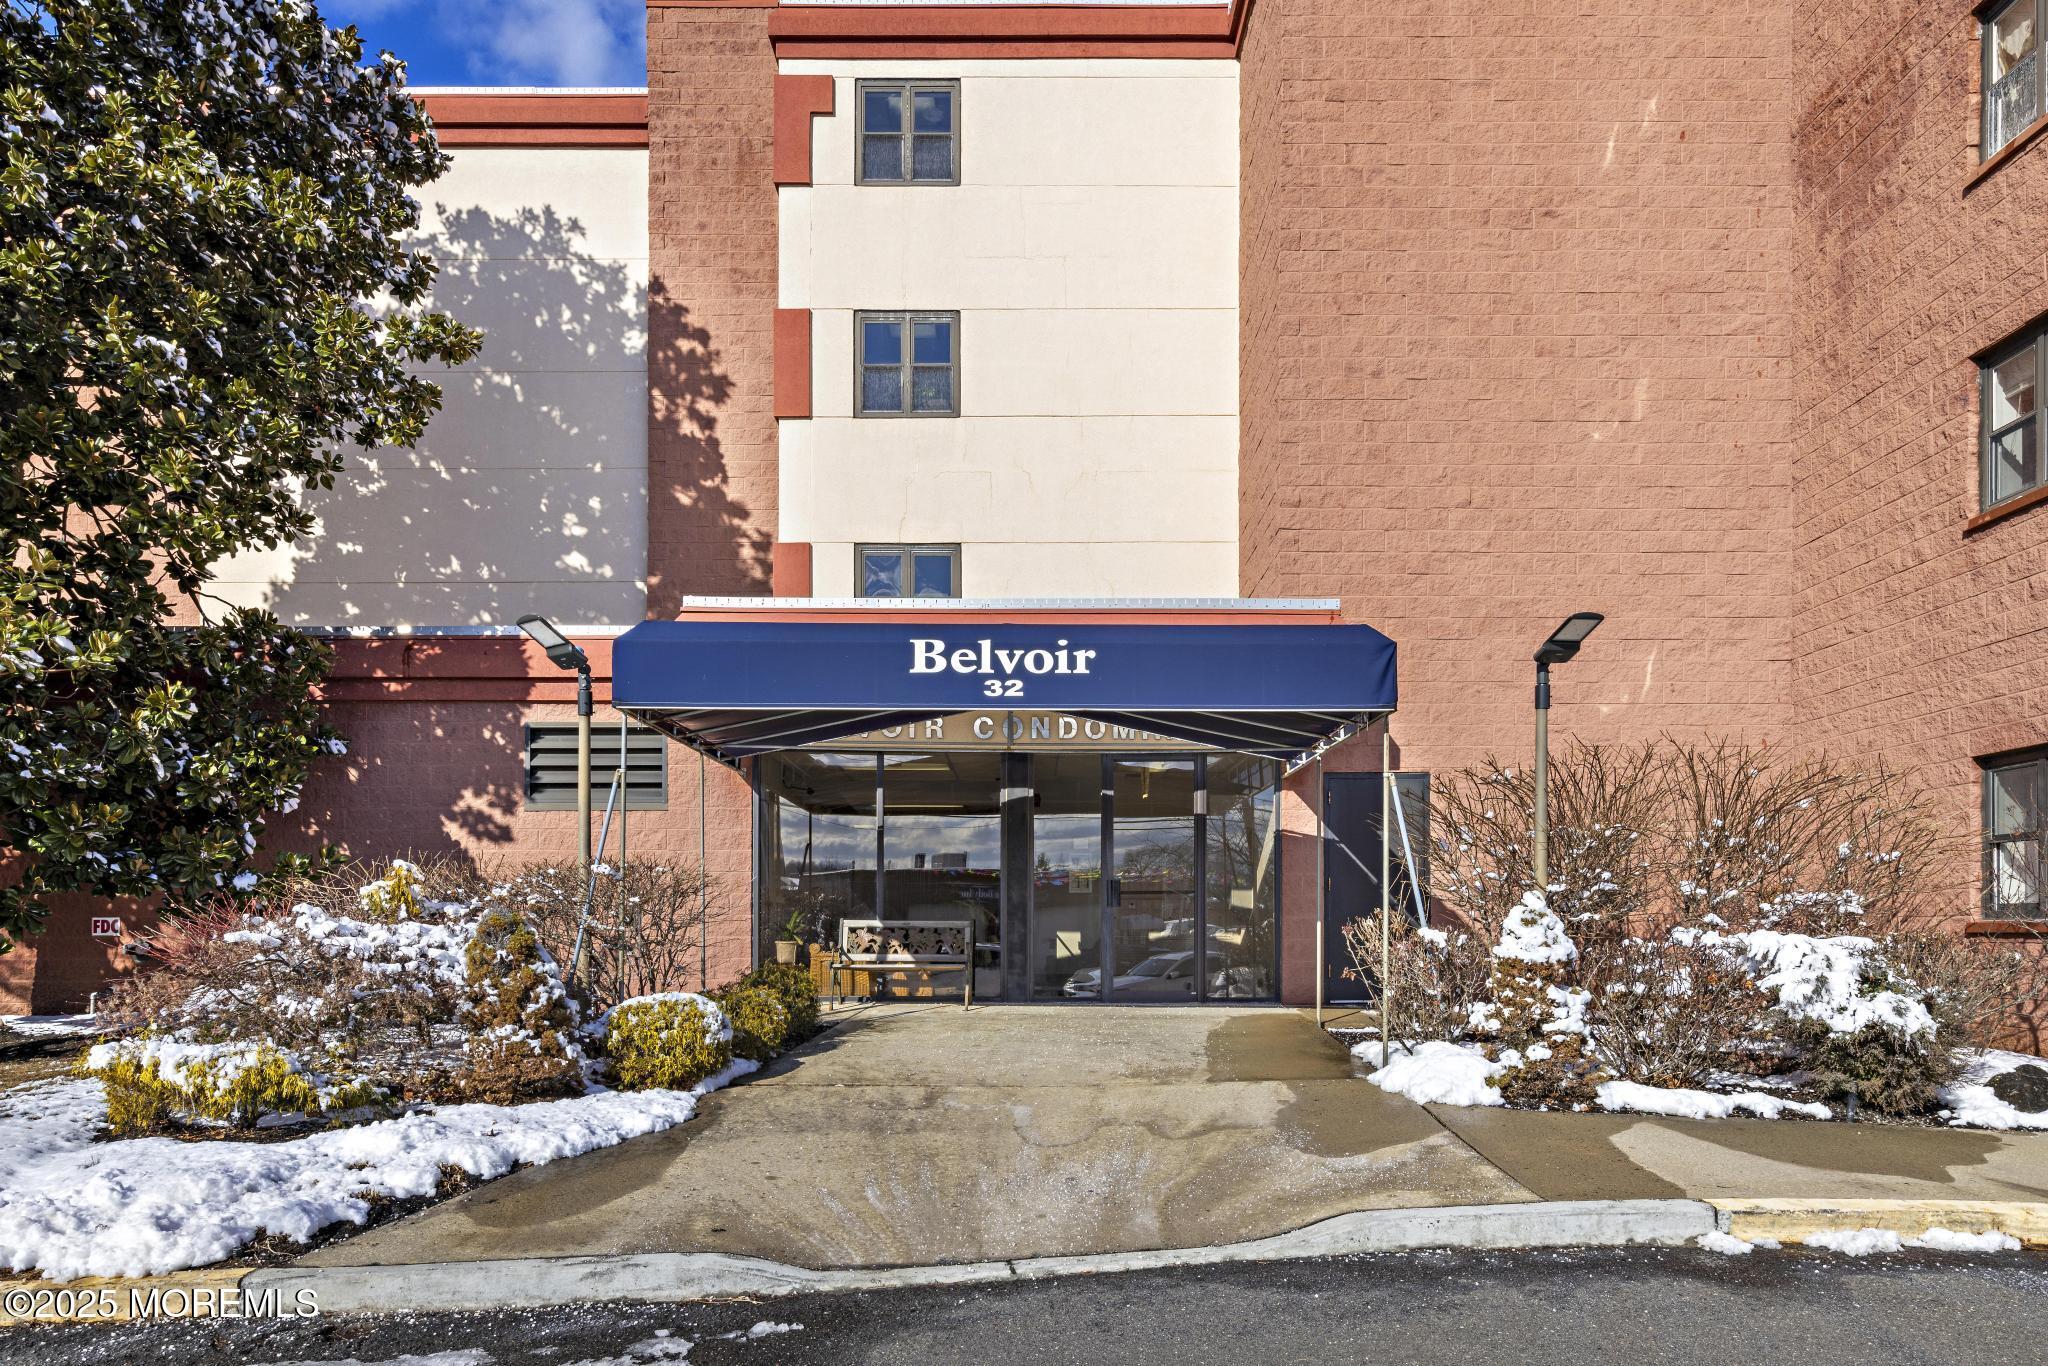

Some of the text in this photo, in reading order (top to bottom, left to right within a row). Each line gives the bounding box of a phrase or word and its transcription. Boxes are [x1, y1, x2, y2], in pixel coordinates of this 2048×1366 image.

[909, 639, 1097, 674] Belvoir
[983, 679, 1024, 697] 32
[93, 919, 119, 934] FDC
